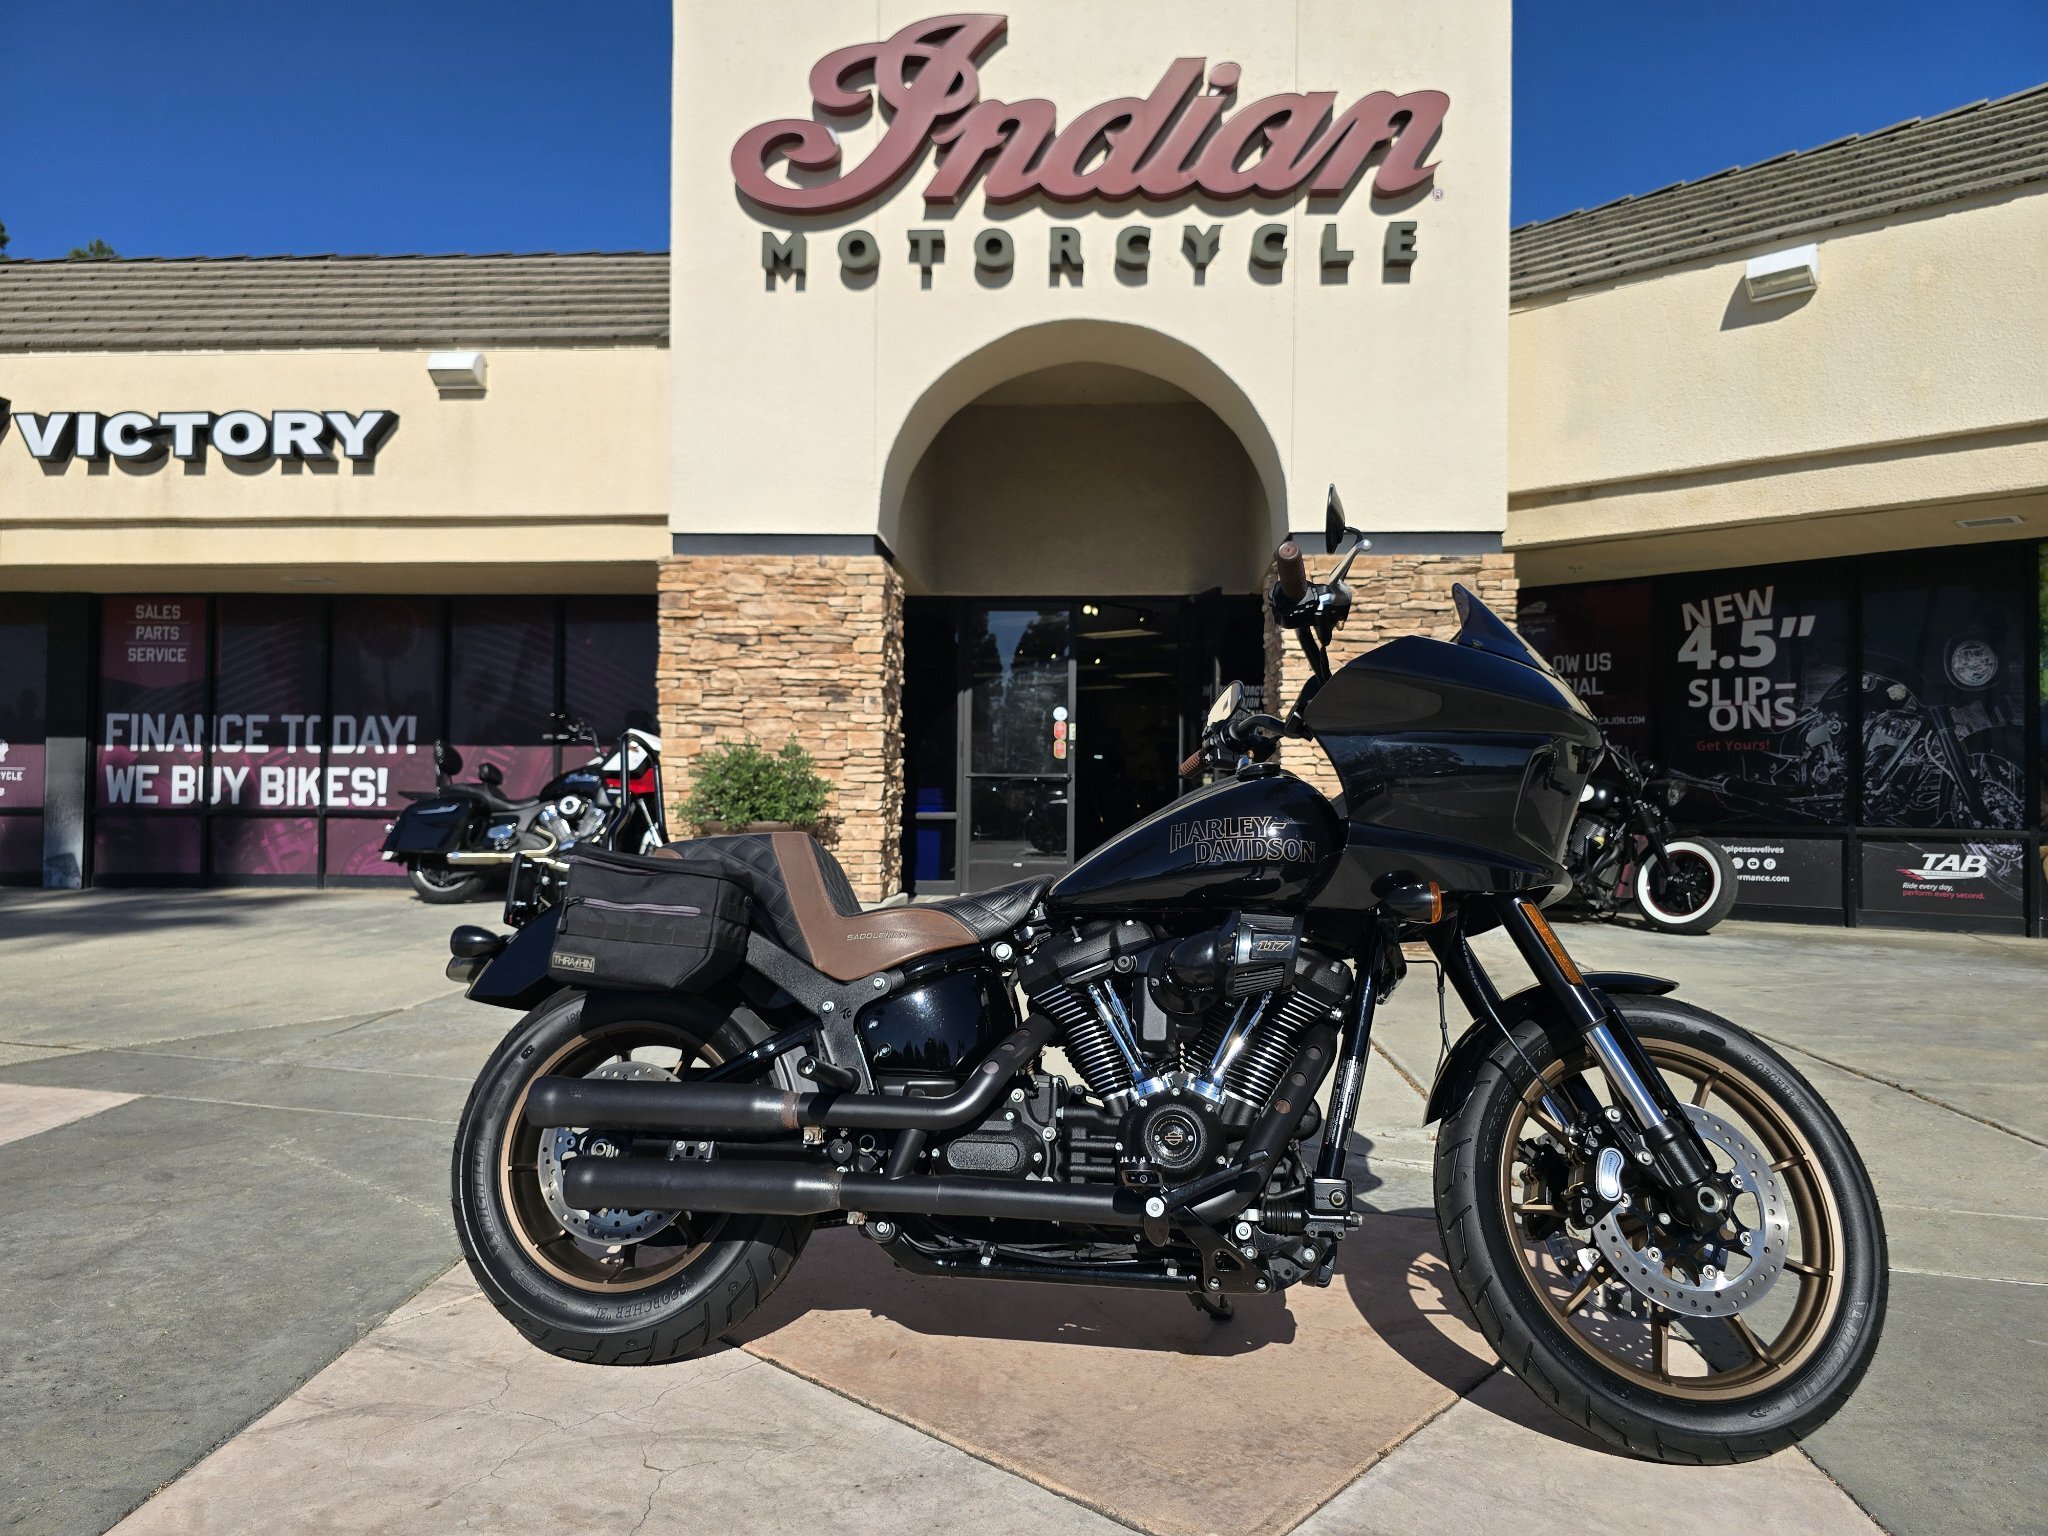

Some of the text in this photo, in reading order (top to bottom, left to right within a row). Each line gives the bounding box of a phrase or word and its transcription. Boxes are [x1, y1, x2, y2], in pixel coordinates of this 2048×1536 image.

[731, 14, 1450, 211] Indian
[762, 222, 1418, 276] MOTORCYCLE
[12, 410, 390, 460] VICTORY
[135, 604, 182, 620] SALES
[1681, 585, 1775, 632] NEW
[135, 625, 180, 640] PARTS
[127, 647, 188, 662] SERVICE
[1552, 652, 1612, 673] OW US
[1566, 677, 1604, 696] IAL
[1688, 676, 1798, 708] SLIP-
[1598, 715, 1646, 726] CAJON.COM
[1708, 696, 1798, 732] ONS
[105, 712, 270, 753] FINANCE
[1696, 739, 1772, 751] Get Yours!
[0, 770, 24, 782] YCLE
[105, 764, 389, 807] WE BUY BIKES!
[1169, 816, 1288, 854] HARLEY-
[1194, 837, 1316, 864] DAVIDSON
[1721, 844, 1785, 854] pipessavelives
[1921, 853, 1988, 875] TAB
[1737, 874, 1790, 883] rmance.com
[1902, 882, 1918, 890] Ride
[1919, 883, 1938, 892] every
[1902, 889, 1933, 897] perform
[1934, 891, 1955, 899] every
[1257, 940, 1291, 951] 117
[616, 1286, 688, 1319] SCORCHER
